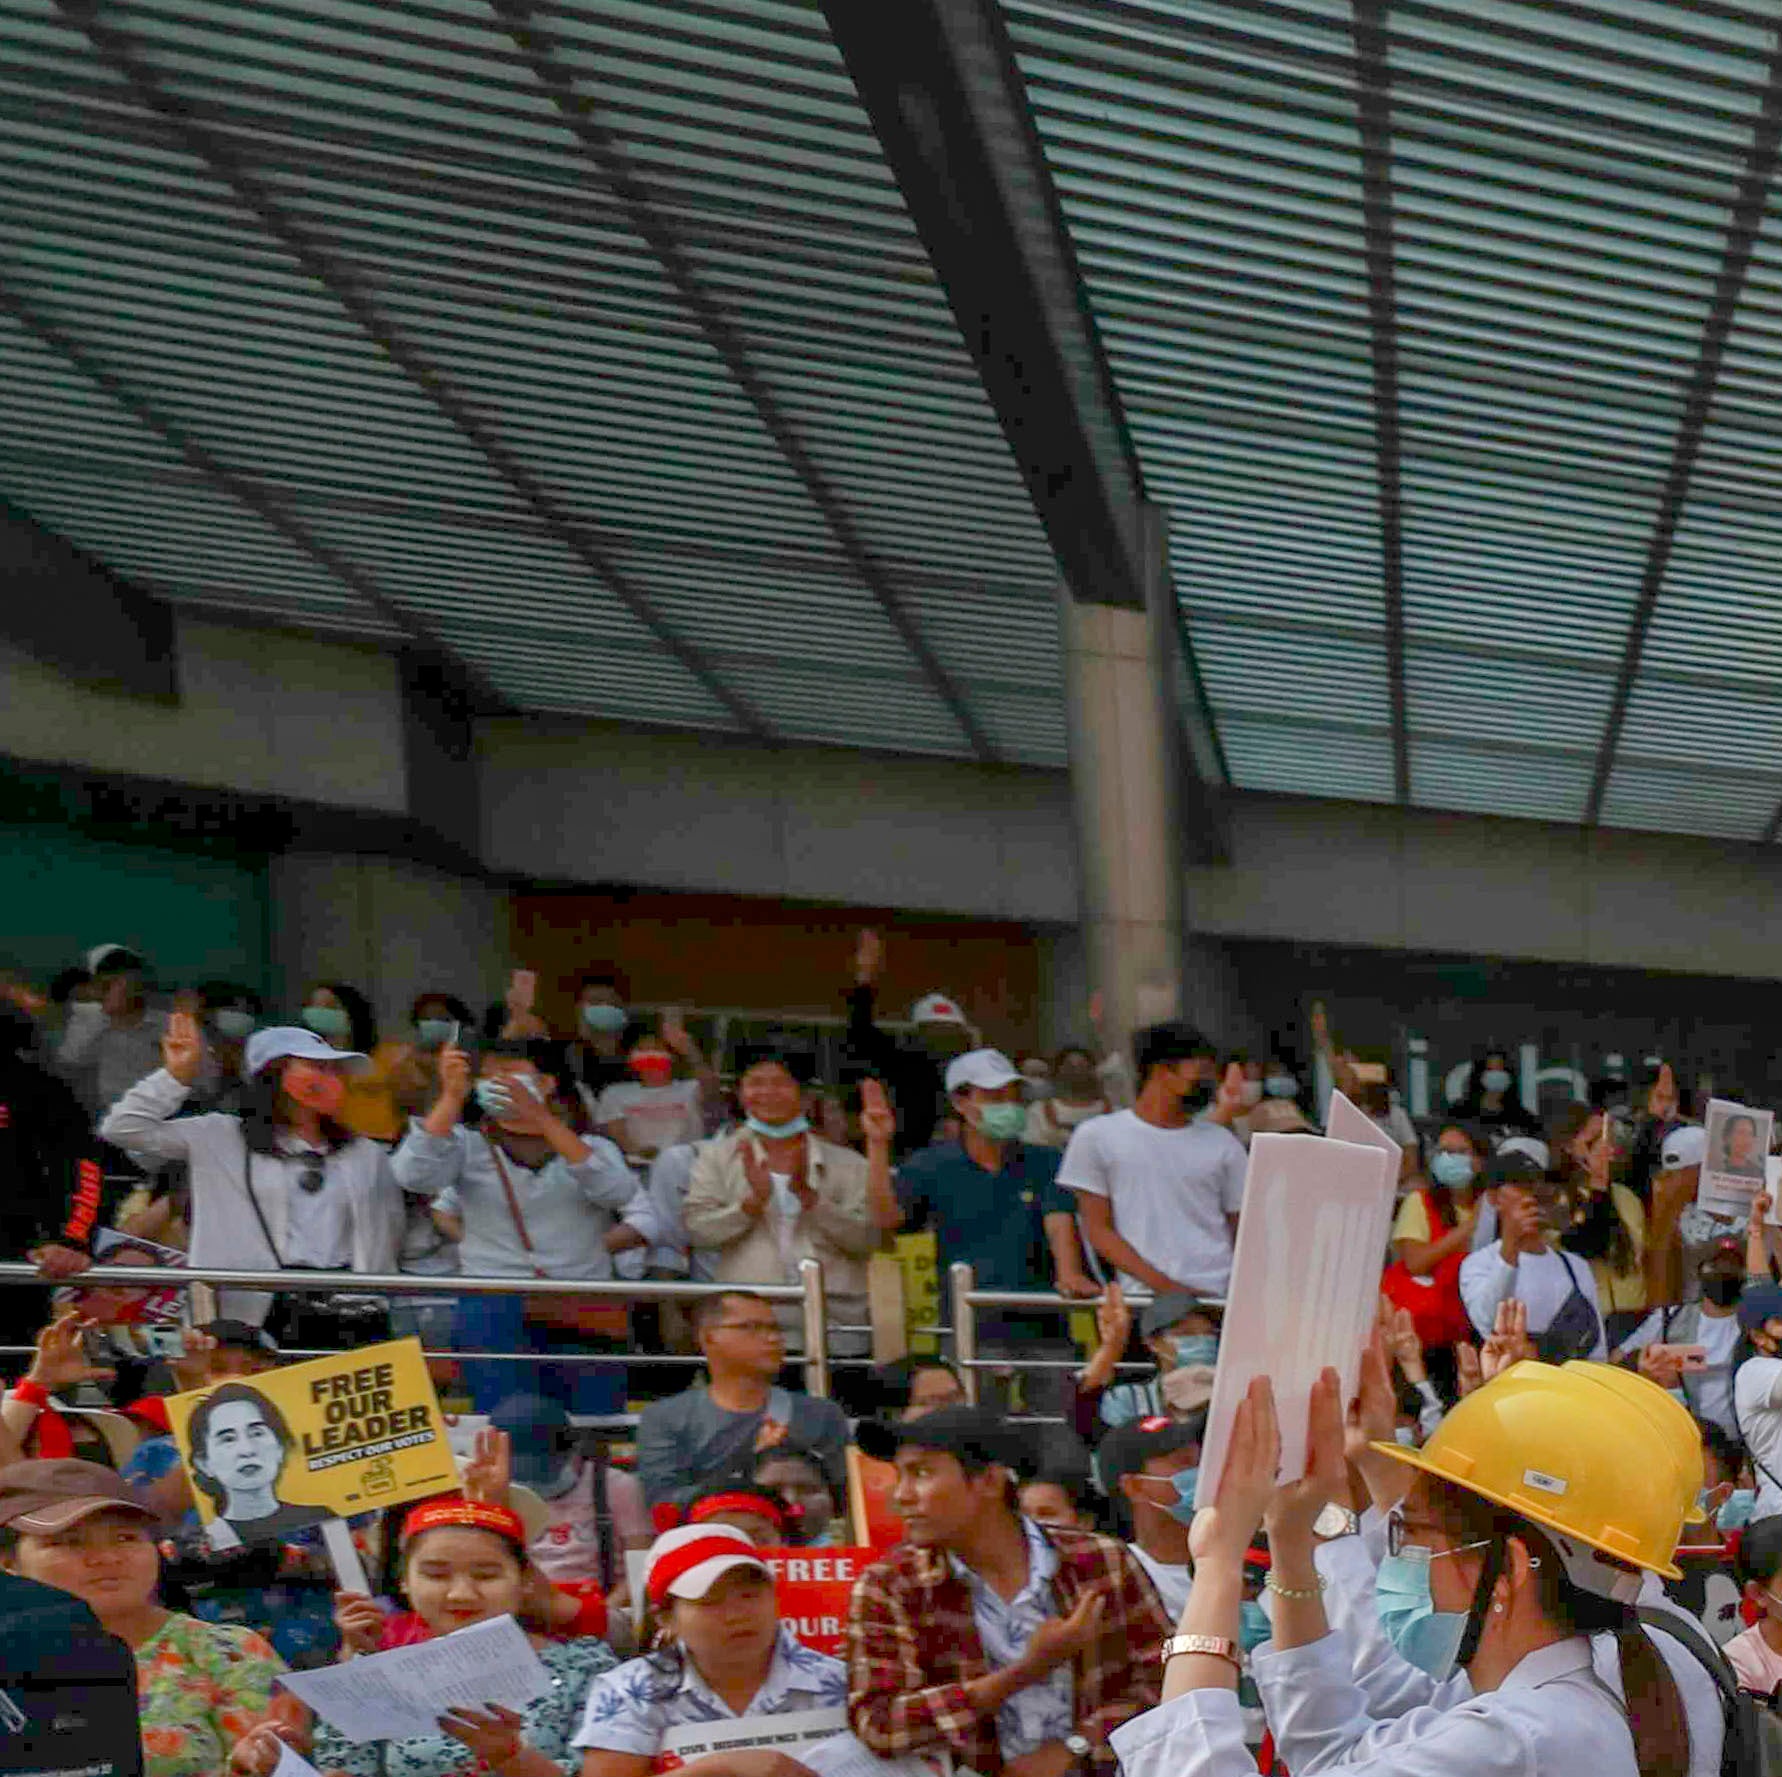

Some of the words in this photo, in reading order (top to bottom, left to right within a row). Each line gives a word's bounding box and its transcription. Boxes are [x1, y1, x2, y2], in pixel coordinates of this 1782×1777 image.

[310, 1363, 394, 1404] FREE
[326, 1390, 393, 1425] OUR
[302, 1405, 431, 1456] LEADER
[308, 1448, 363, 1471] RESPECT
[365, 1440, 394, 1457] OUR
[395, 1431, 436, 1451] VOTES
[766, 1558, 855, 1581] FREE
[780, 1616, 839, 1636] OUR
